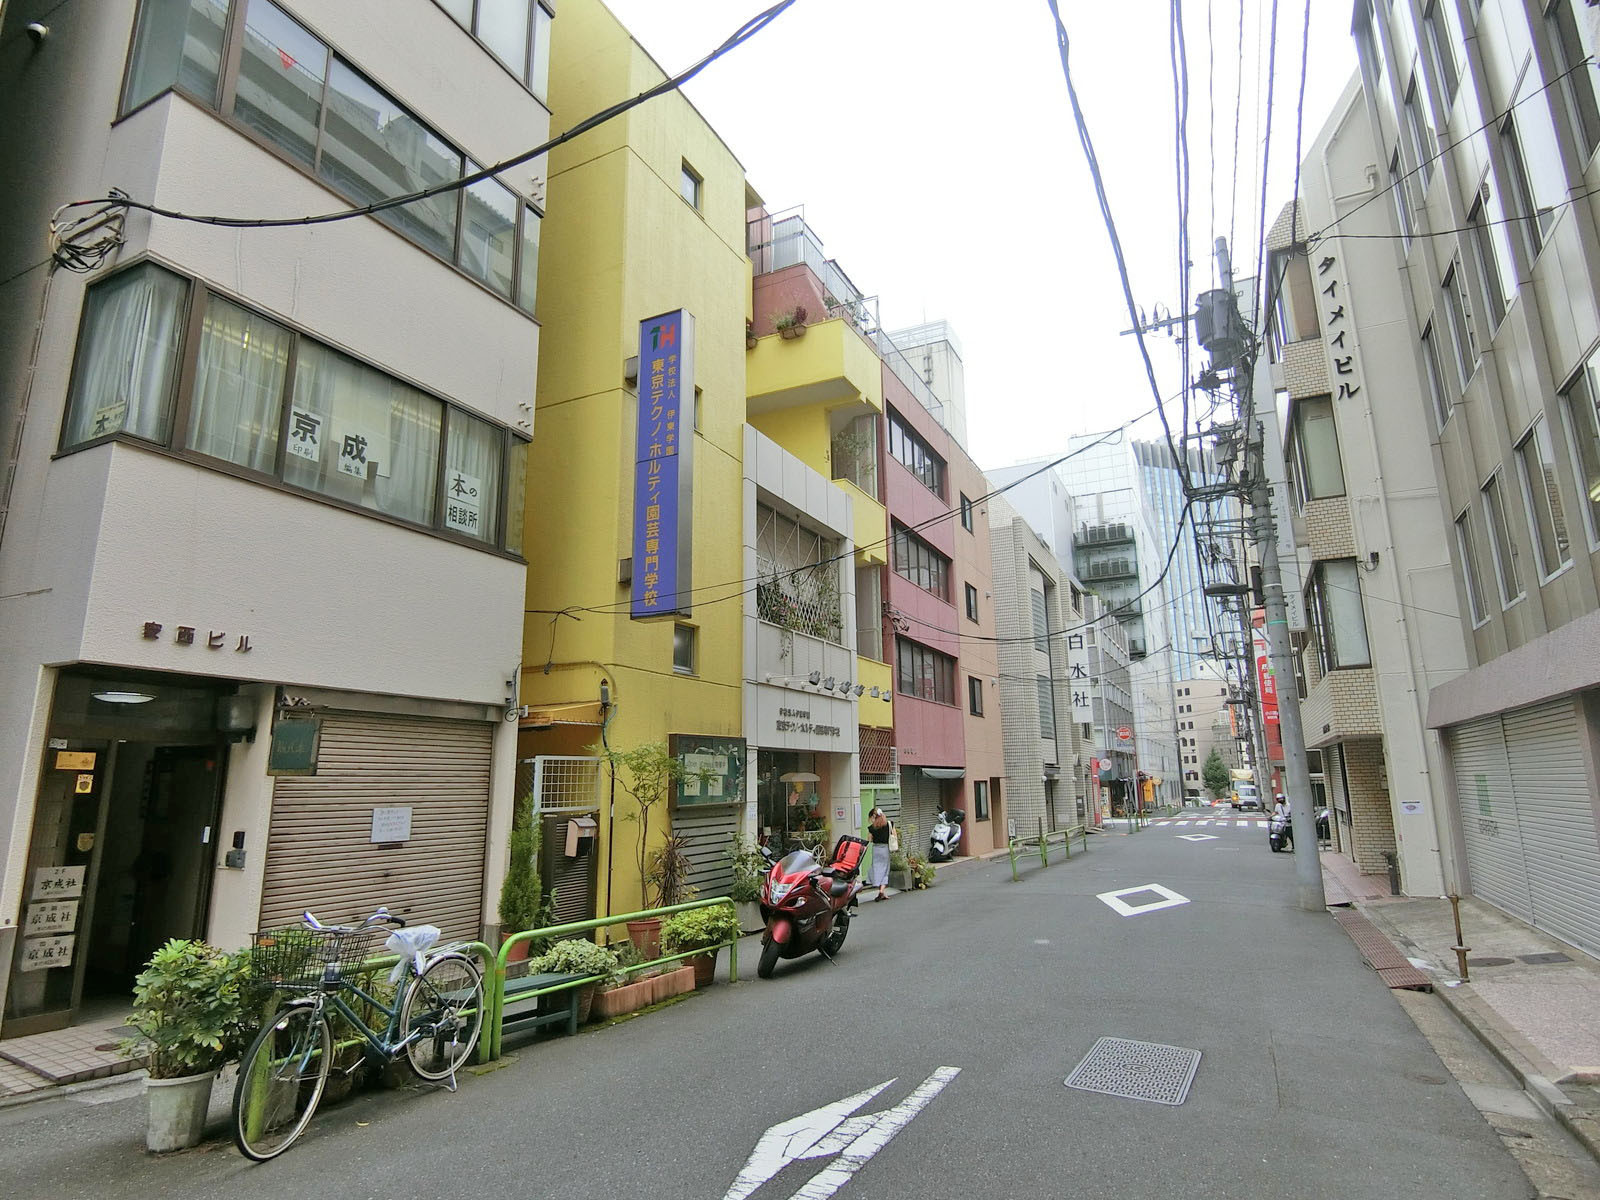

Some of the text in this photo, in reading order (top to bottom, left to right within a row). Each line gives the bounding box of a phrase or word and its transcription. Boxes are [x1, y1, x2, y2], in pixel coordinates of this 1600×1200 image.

[1317, 256, 1360, 401] タイメイビル
[291, 410, 368, 465] 京 成
[293, 443, 314, 459] 印刷
[451, 473, 478, 498] 本の
[448, 504, 478, 529] 相談所
[1068, 633, 1090, 707] 白水社
[40, 878, 77, 891] 京成社
[30, 911, 72, 924] 京成社
[28, 945, 69, 961] 京成社
